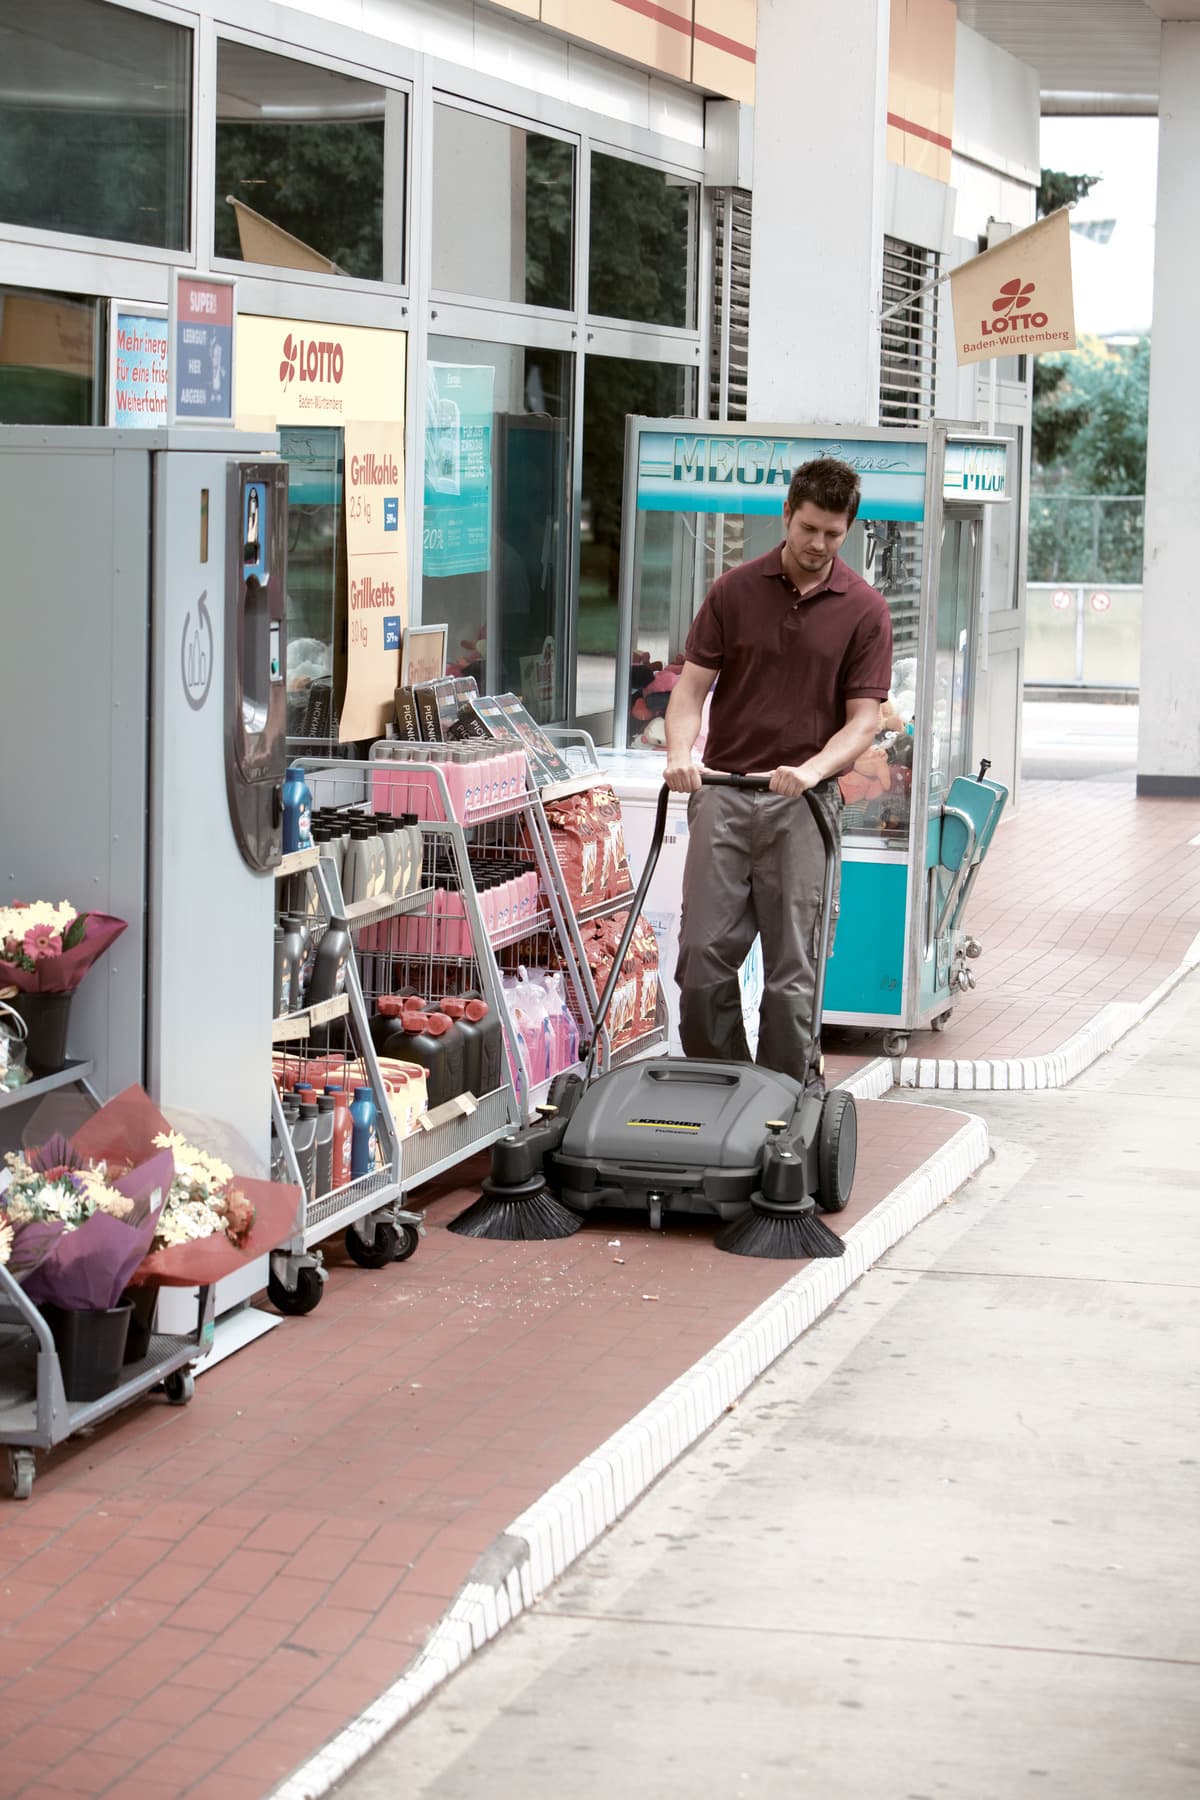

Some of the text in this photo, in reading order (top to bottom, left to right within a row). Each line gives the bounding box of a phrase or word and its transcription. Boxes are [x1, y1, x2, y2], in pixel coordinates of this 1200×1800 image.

[189, 291, 217, 314] SUPER!
[981, 312, 1049, 337] LOTTO
[116, 328, 144, 353] Mehr
[962, 330, 1070, 354] Baden-Württemberg
[116, 357, 129, 381] Für
[131, 360, 150, 384] eine
[299, 339, 344, 384] LOTTO
[116, 389, 168, 413] Weiterfahrt
[351, 453, 398, 486] Grillkohle
[672, 436, 796, 486] MEGA
[350, 496, 361, 520] 2,5
[350, 577, 396, 611] Grillketts
